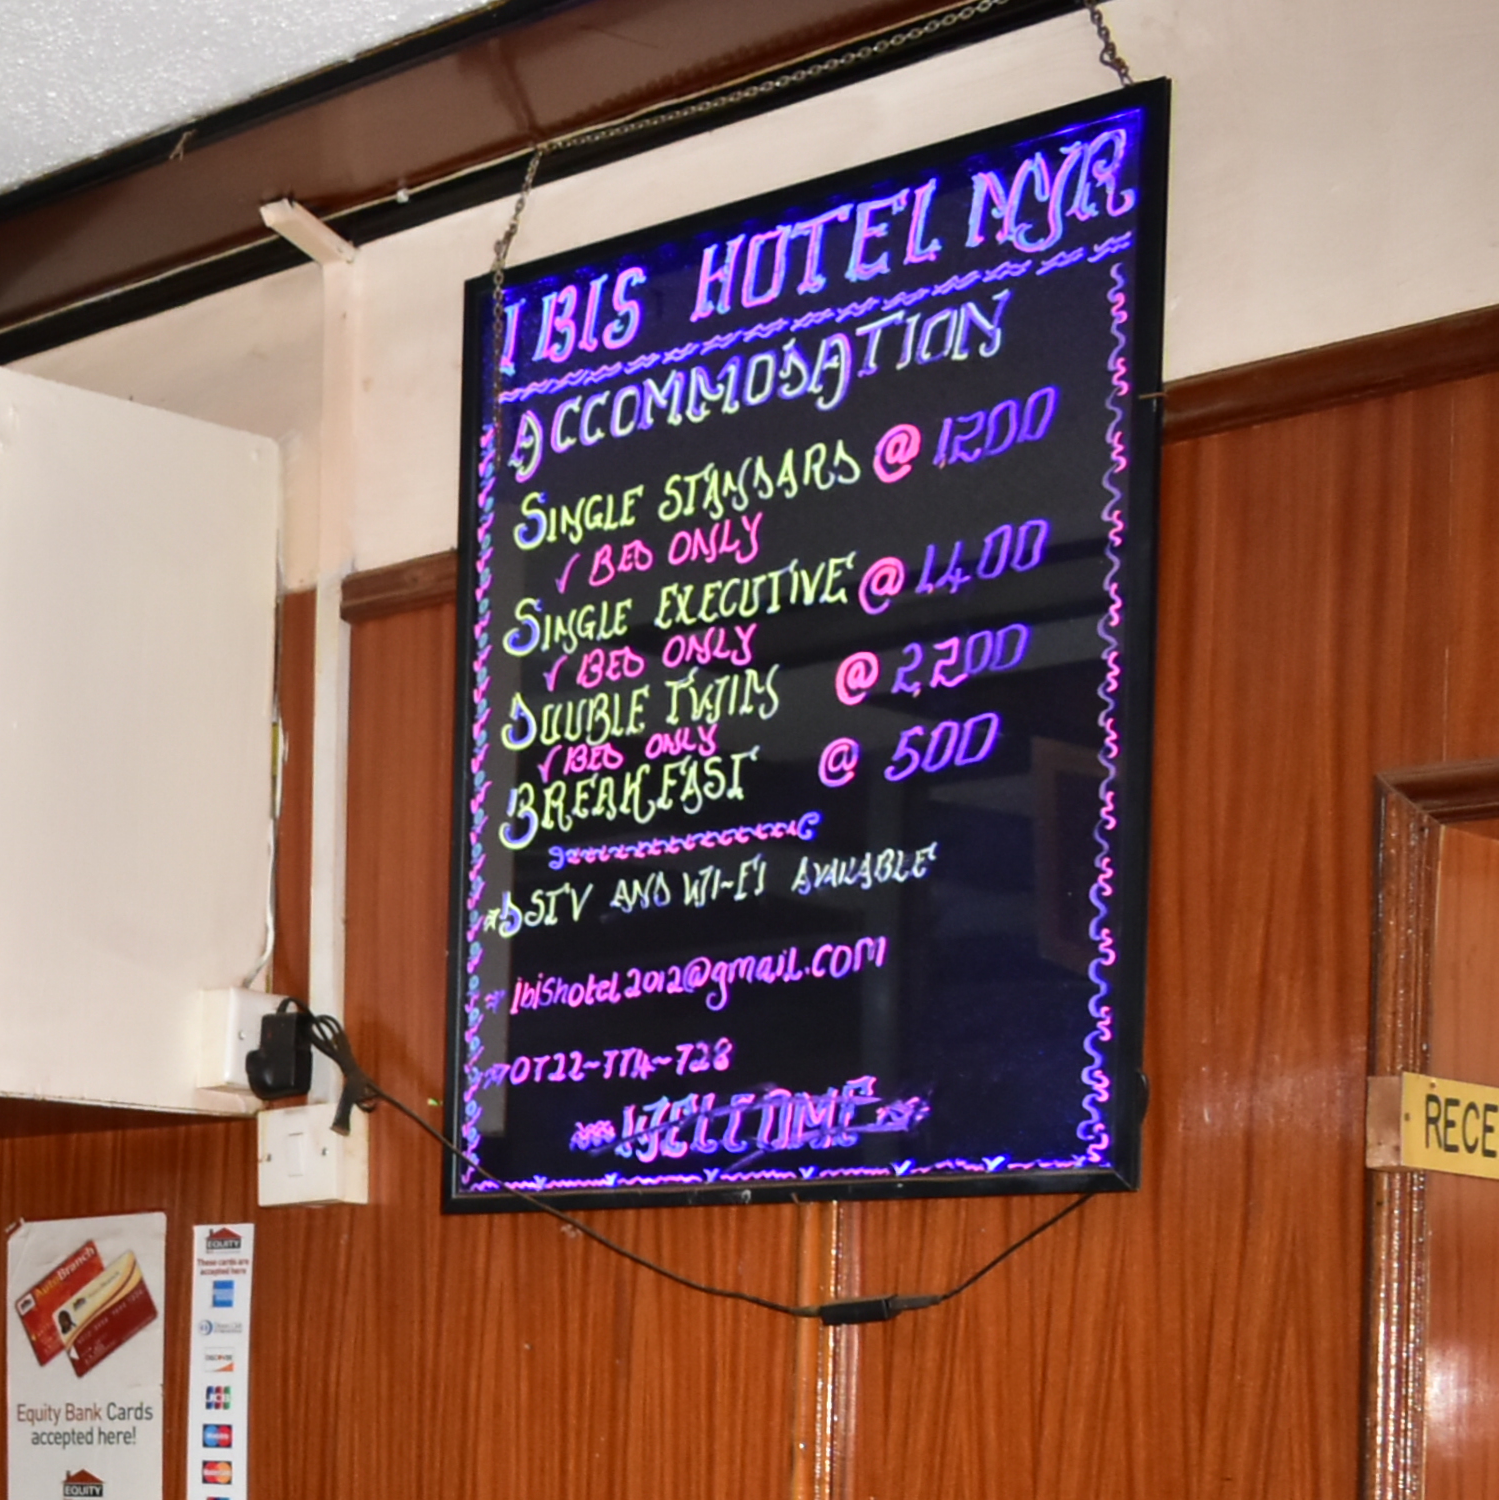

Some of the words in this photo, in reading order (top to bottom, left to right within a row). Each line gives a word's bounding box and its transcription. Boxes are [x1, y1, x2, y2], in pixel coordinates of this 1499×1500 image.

[692, 179, 941, 321] HOTEL
[509, 290, 1012, 482] ACCOMMODATION
[515, 486, 645, 549] SINGLE
[659, 442, 861, 521] STANDARD
[589, 541, 654, 586] BED
[669, 513, 763, 567] ONLY
[504, 596, 631, 655] SINGLE
[654, 552, 856, 629] EXECUTIVE
[576, 651, 645, 688] BED
[664, 624, 757, 667] ONLY
[503, 688, 646, 749] DOUBLE
[664, 665, 779, 724] TWINS
[498, 746, 759, 849] BREAKFAST
[884, 713, 999, 783] 500
[564, 741, 623, 776] BED
[646, 724, 717, 759] ONLY
[610, 871, 671, 913] AND
[792, 843, 937, 894] AVAILABLE
[197, 1258, 216, 1267] These
[218, 1258, 236, 1267] cards
[207, 1239, 240, 1249] EQUITY
[17, 1402, 63, 1426] Equity
[65, 1403, 102, 1422] Bank
[106, 1403, 154, 1422] Cards
[31, 1426, 95, 1447] accepted
[98, 1426, 137, 1445] here!
[63, 1485, 103, 1498] EQUITY
